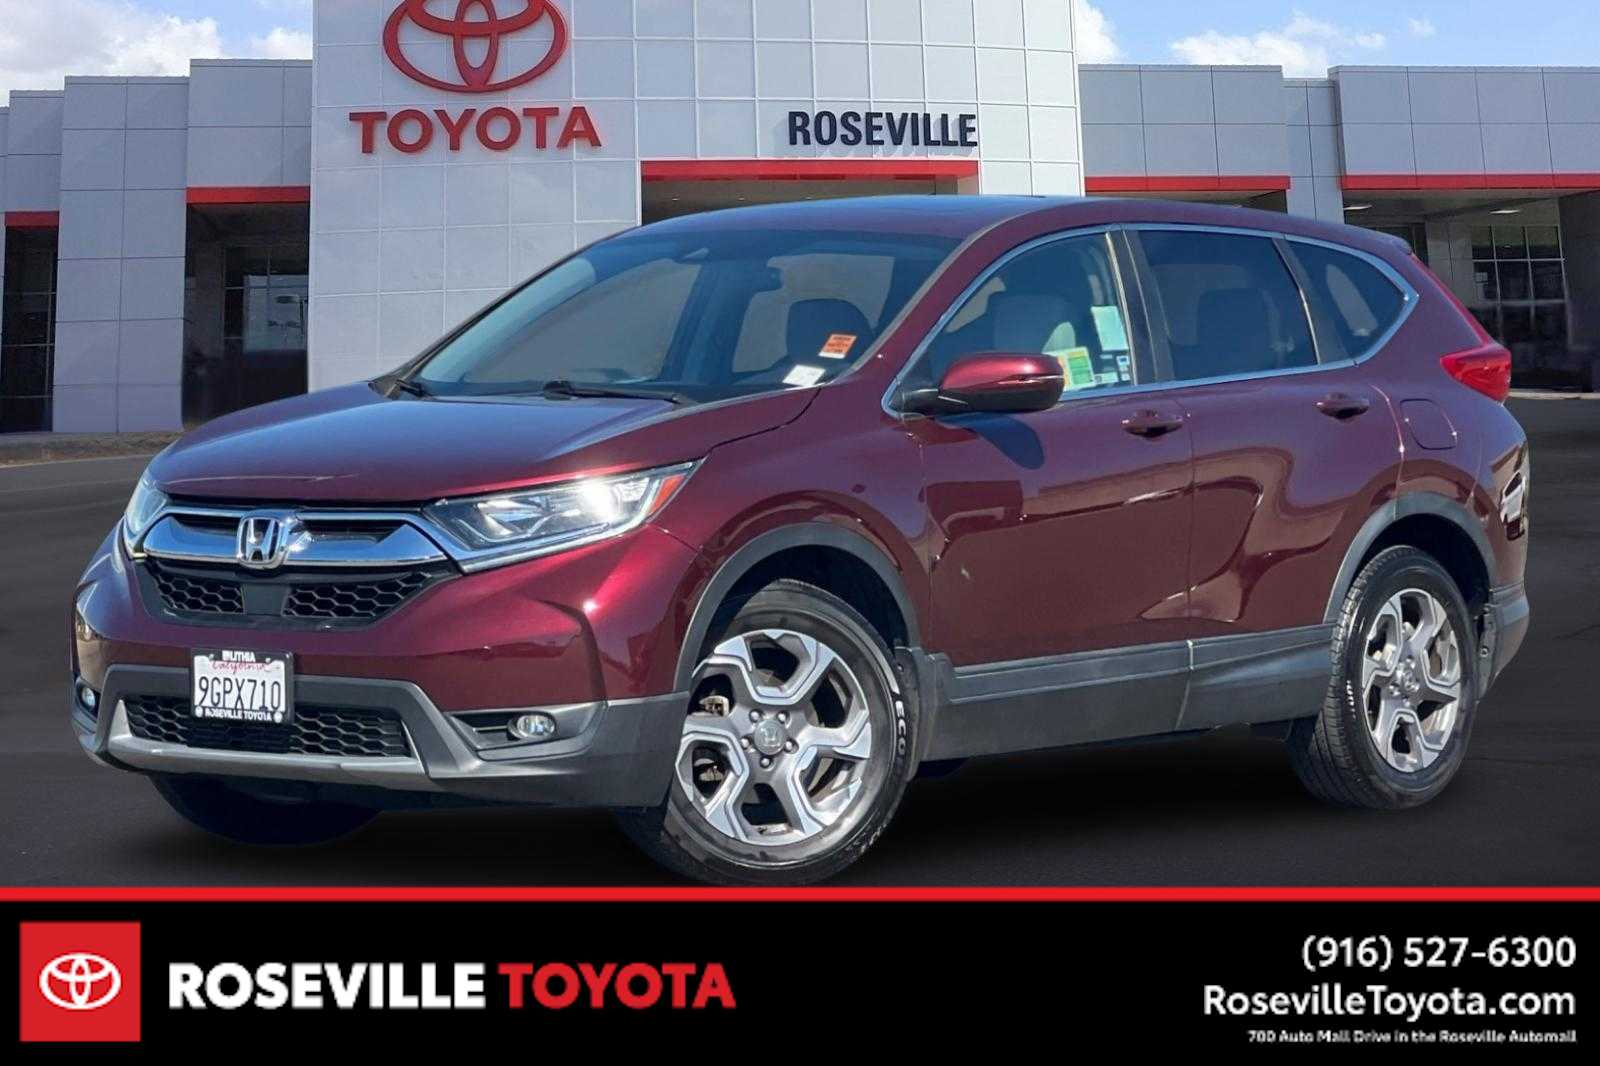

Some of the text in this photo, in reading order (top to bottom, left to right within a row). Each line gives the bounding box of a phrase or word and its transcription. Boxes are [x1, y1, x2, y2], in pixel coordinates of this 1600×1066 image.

[349, 106, 602, 154] TOYOTA
[788, 110, 979, 147] ROSEVILLE
[199, 676, 281, 711] 9GPX710
[204, 707, 272, 721] ROSEVILLE TOYOTA
